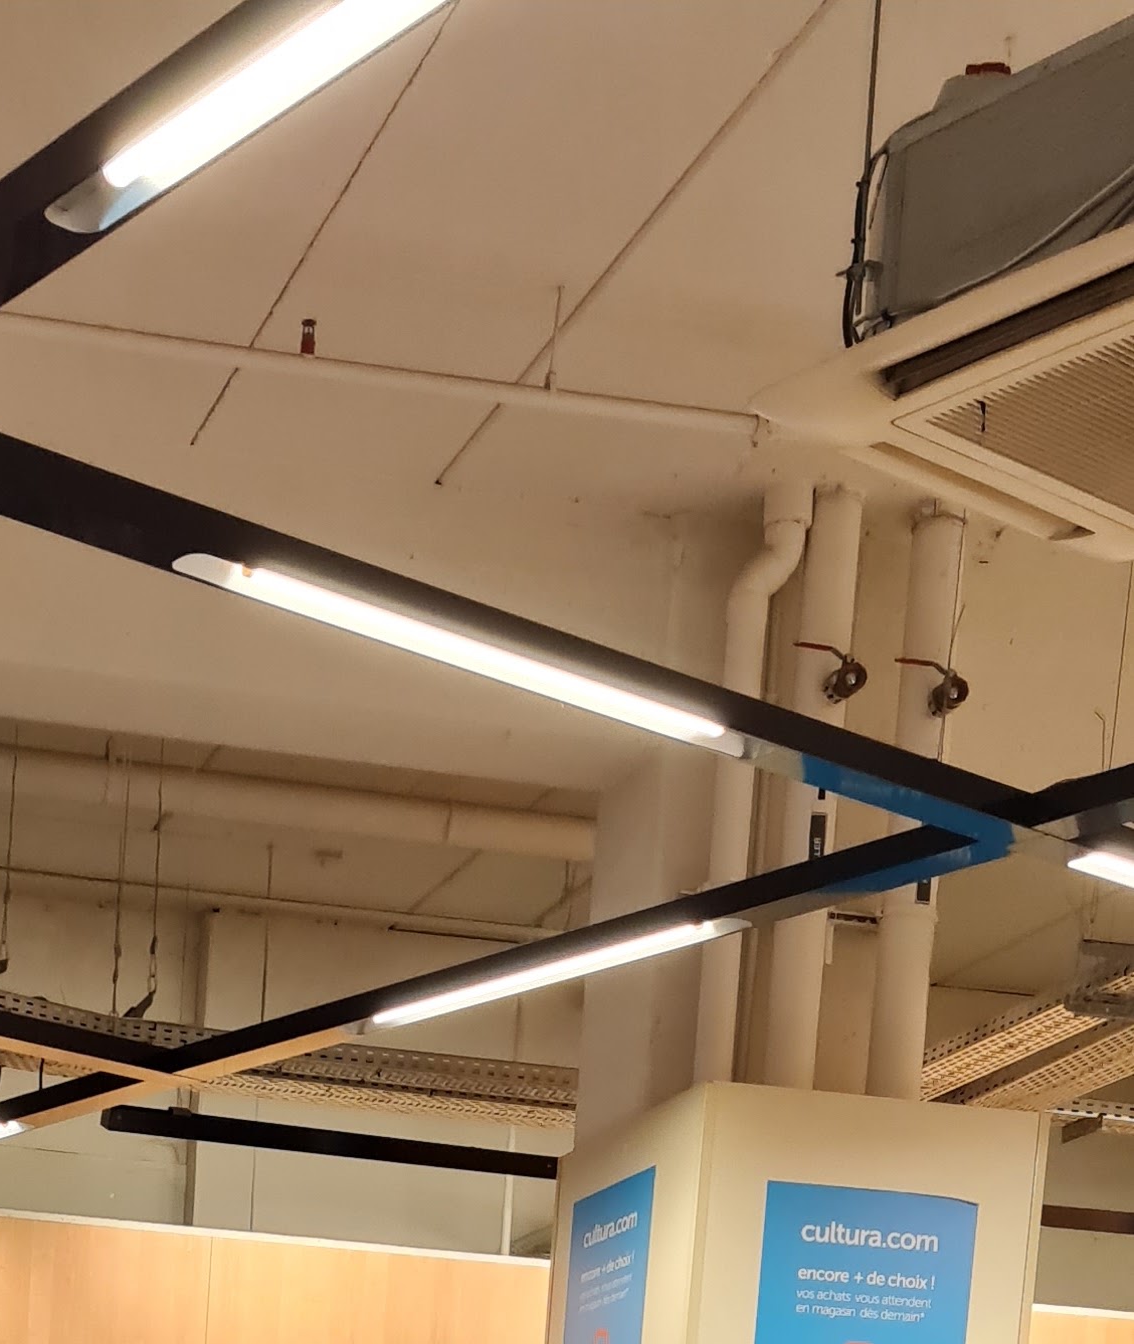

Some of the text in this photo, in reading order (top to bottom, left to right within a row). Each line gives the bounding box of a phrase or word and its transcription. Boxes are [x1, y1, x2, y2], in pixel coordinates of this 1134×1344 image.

[583, 1211, 638, 1249] cultura.com
[801, 1221, 939, 1252] cultura.com
[797, 1266, 936, 1290] encore + de choix !
[796, 1288, 932, 1309] vos achats vous attendent
[796, 1305, 809, 1314] en
[812, 1305, 856, 1319] magasin
[860, 1306, 878, 1319] dès
